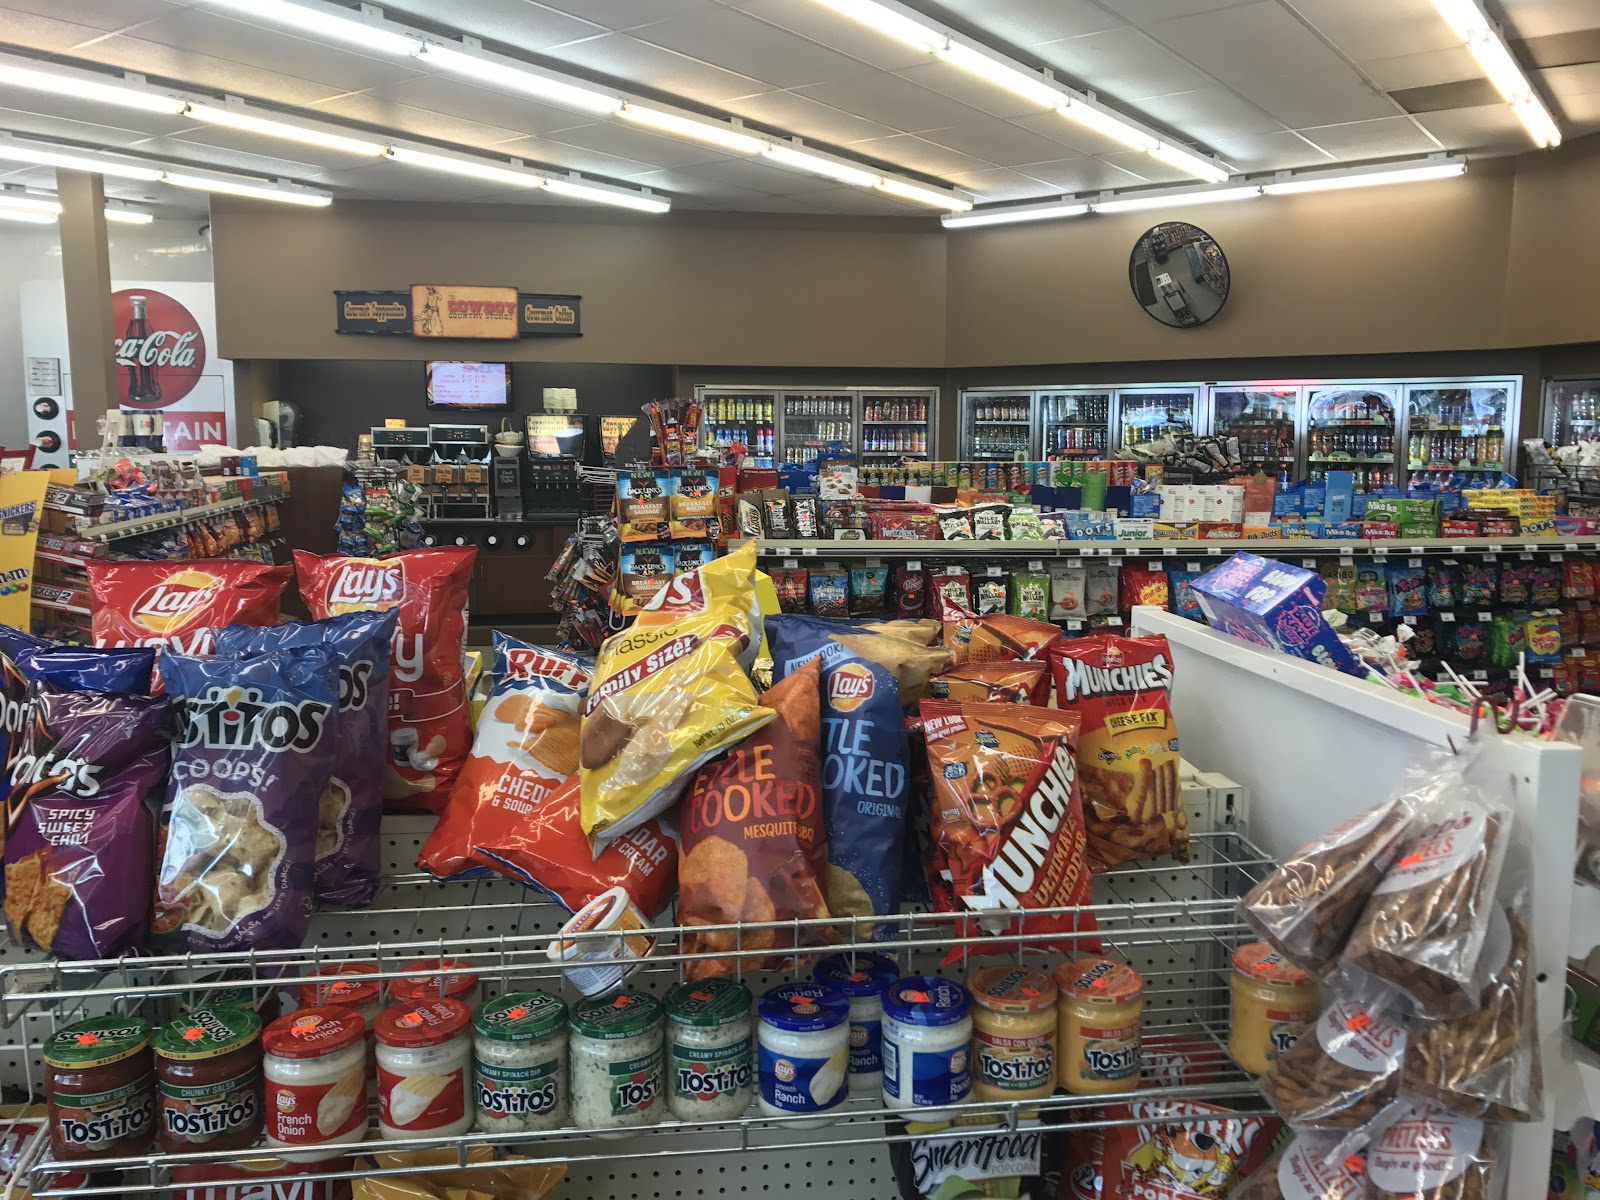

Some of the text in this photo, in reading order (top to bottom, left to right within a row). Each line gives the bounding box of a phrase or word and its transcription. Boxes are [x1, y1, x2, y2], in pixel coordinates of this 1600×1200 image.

[448, 300, 516, 314] COWBOY
[1368, 500, 1398, 512] Mike Ike
[881, 526, 917, 538] Twizzlers
[1076, 522, 1112, 537] DOTS
[1118, 529, 1148, 537] Junior
[1521, 519, 1555, 533] DOTS
[1327, 571, 1354, 579] ARIBO
[330, 565, 399, 604] Lay's
[137, 586, 217, 617] Lay's
[585, 636, 693, 717] Family Size!
[1062, 653, 1173, 702] MUNCHIES
[831, 672, 872, 698] Lay's
[924, 715, 964, 733] NEW LOOK
[1109, 711, 1157, 729] CHEESE FIX
[172, 758, 279, 791] COOPS!
[491, 795, 500, 807] &
[48, 809, 96, 820] SPICY
[857, 801, 902, 819] ORIGINAL
[38, 822, 94, 833] SWEET
[744, 820, 799, 839] MESQUITE
[960, 737, 1076, 912] MUNCHIE
[617, 842, 654, 877] CREAM
[1033, 812, 1078, 906] ULTIMATE
[936, 985, 950, 1008] Ranch
[303, 1027, 344, 1042] Onion
[1102, 1030, 1119, 1038] SALSA
[991, 1038, 1010, 1046] SALSA
[1011, 1038, 1025, 1046] CON
[688, 1050, 713, 1058] CREAMY
[481, 1065, 542, 1078] CREAMY SPINACH DIP
[774, 1064, 795, 1076] Lay's
[981, 1051, 1052, 1080] TOSTITOS
[80, 1085, 136, 1106] CHUNKY SALSA
[181, 1080, 236, 1097] CHUNKY SALSA
[276, 1093, 297, 1106] Lay's
[478, 1082, 556, 1113] TOSTITOS
[774, 1089, 806, 1105] Ranch
[774, 1099, 783, 1108] Dip
[165, 1096, 255, 1136] TOSTITOS
[277, 1112, 312, 1125] French
[277, 1125, 305, 1136] Onion
[911, 1125, 1041, 1193] Smartfood
[991, 1162, 1037, 1175] POPCORN
